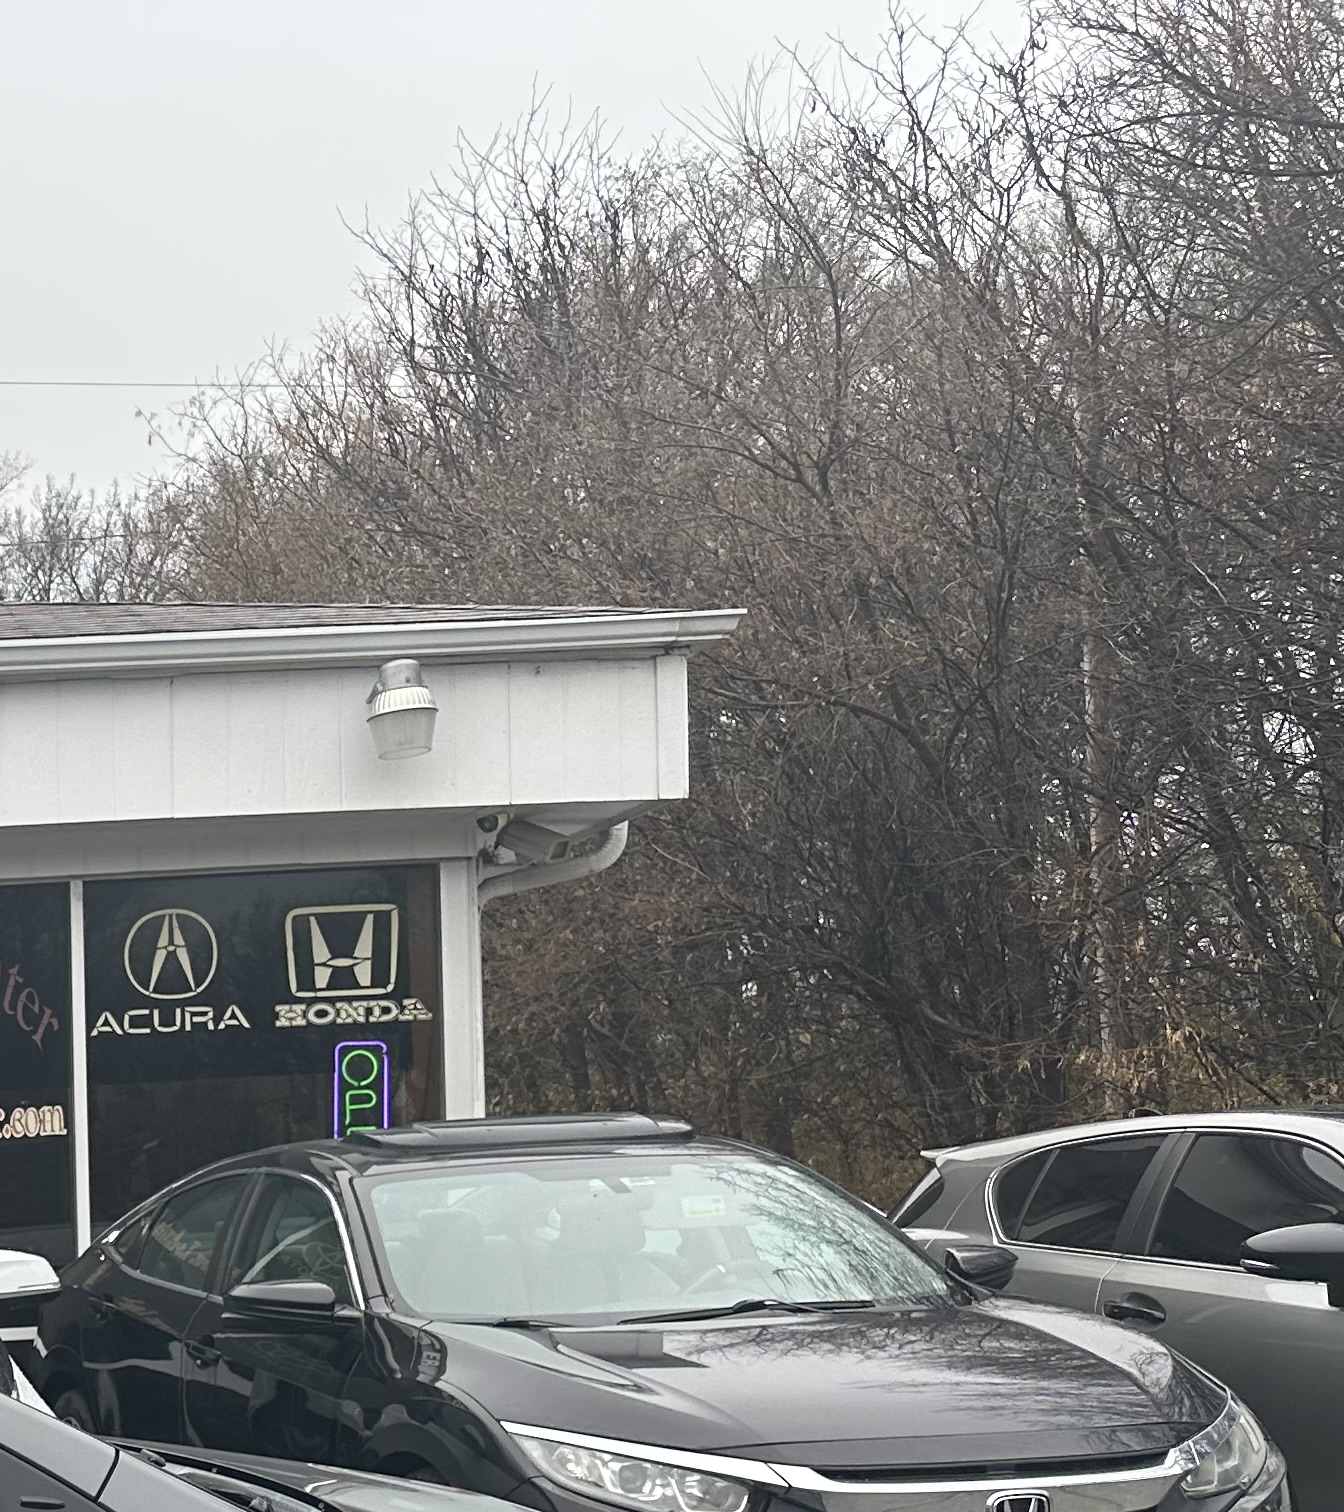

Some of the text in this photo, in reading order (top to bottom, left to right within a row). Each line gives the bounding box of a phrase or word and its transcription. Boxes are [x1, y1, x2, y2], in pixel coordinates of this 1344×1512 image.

[90, 1004, 251, 1037] ACURA
[275, 998, 432, 1028] HONDA
[342, 1050, 377, 1136] OP
